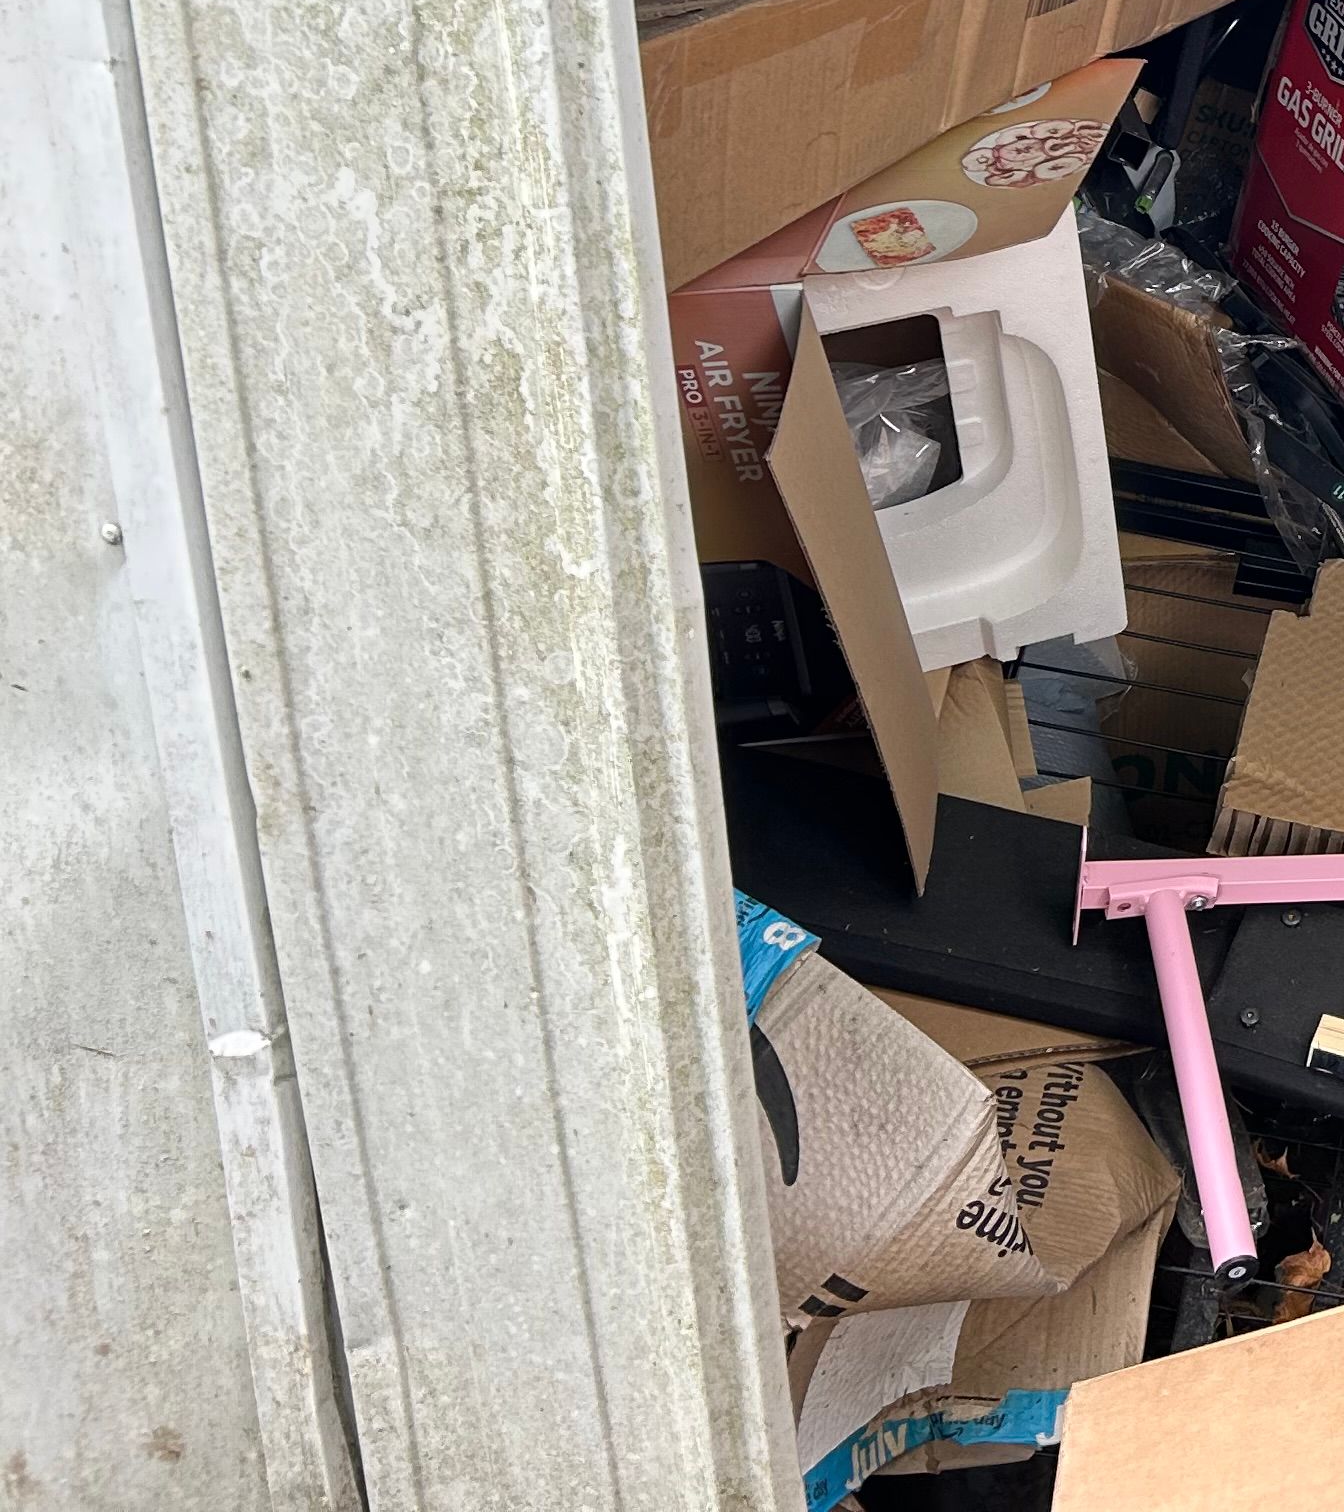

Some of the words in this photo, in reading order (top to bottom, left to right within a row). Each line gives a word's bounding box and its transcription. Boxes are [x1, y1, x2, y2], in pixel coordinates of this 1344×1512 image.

[1276, 77, 1313, 129] GAS
[1305, 80, 1343, 128] 3-BURNER
[678, 369, 703, 404] PRO
[692, 412, 719, 456] 3-IN-1
[694, 340, 733, 387] AIR
[714, 395, 763, 482] FRYER
